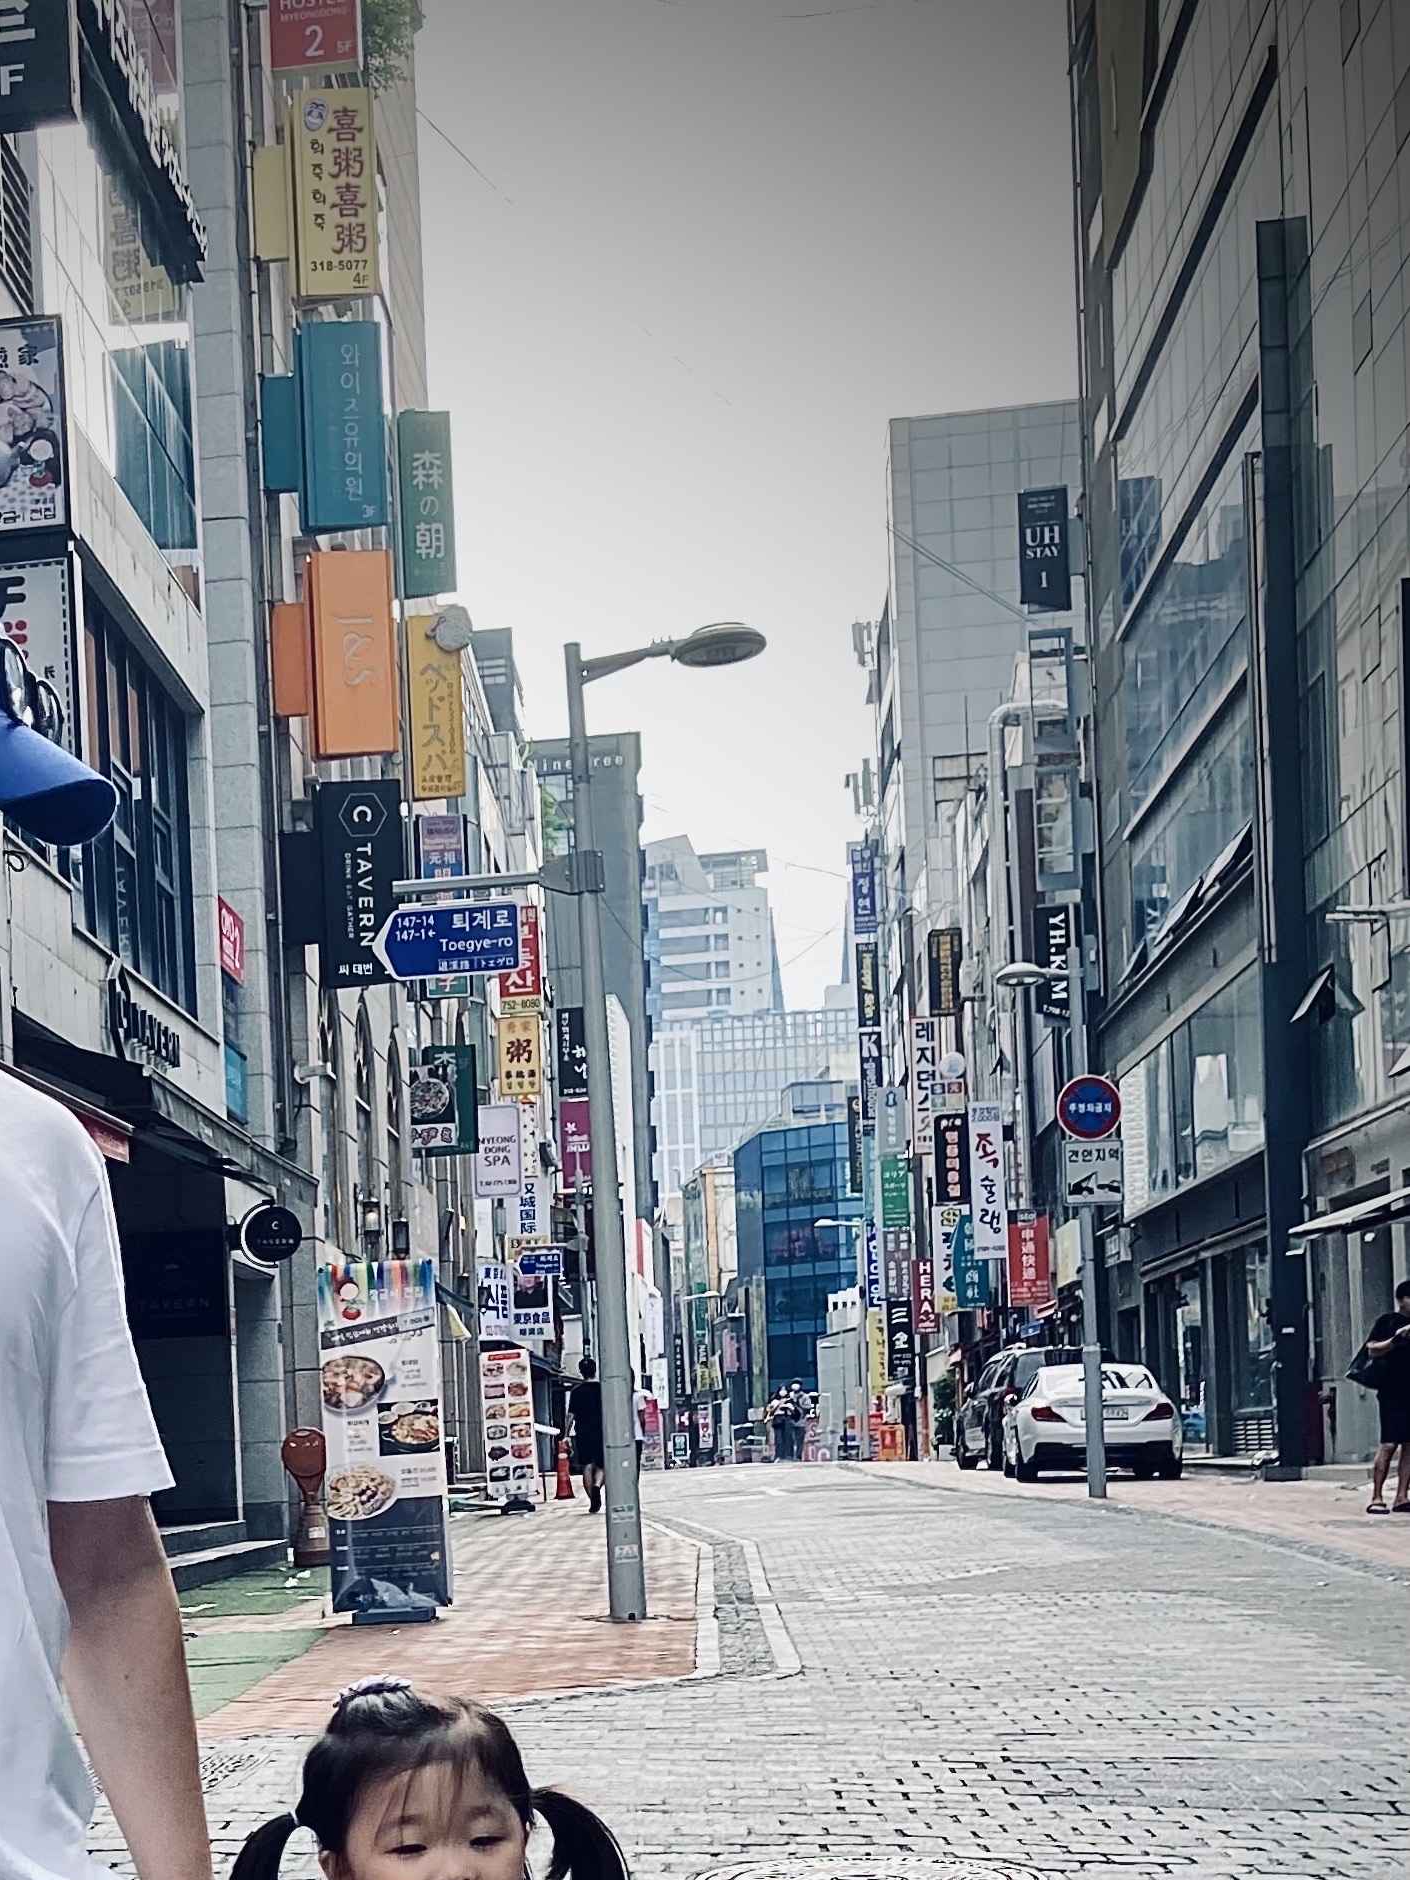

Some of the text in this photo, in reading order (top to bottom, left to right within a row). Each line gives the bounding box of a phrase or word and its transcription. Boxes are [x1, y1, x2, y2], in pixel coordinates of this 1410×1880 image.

[304, 25, 353, 57] 2 5F
[310, 138, 326, 231] 희죽희죽
[327, 106, 366, 254] 喜粥喜粥
[311, 260, 368, 272] 318-5077
[353, 272, 369, 284] 4F
[340, 343, 363, 502] 와이즈유의원
[412, 450, 445, 559] 森の朝
[29, 505, 56, 521] 전집
[1025, 525, 1060, 547] UH
[1025, 545, 1060, 560] STAY
[1041, 571, 1048, 588] 1
[356, 842, 376, 948] TAVERN
[397, 915, 435, 928] 147-14
[452, 909, 513, 931] 퇴계로
[395, 929, 426, 941] 147-1
[439, 936, 514, 954] Toegye-ro
[506, 1038, 533, 1064] 粥
[1068, 1102, 1112, 1114] 주정차금지
[484, 1144, 511, 1154] DONG
[1068, 1148, 1120, 1164] 견인지역
[484, 1155, 511, 1167] SPA
[256, 1237, 295, 1246] TAVERN
[918, 1261, 934, 1314] HERA
[513, 1312, 551, 1326] 東京食品
